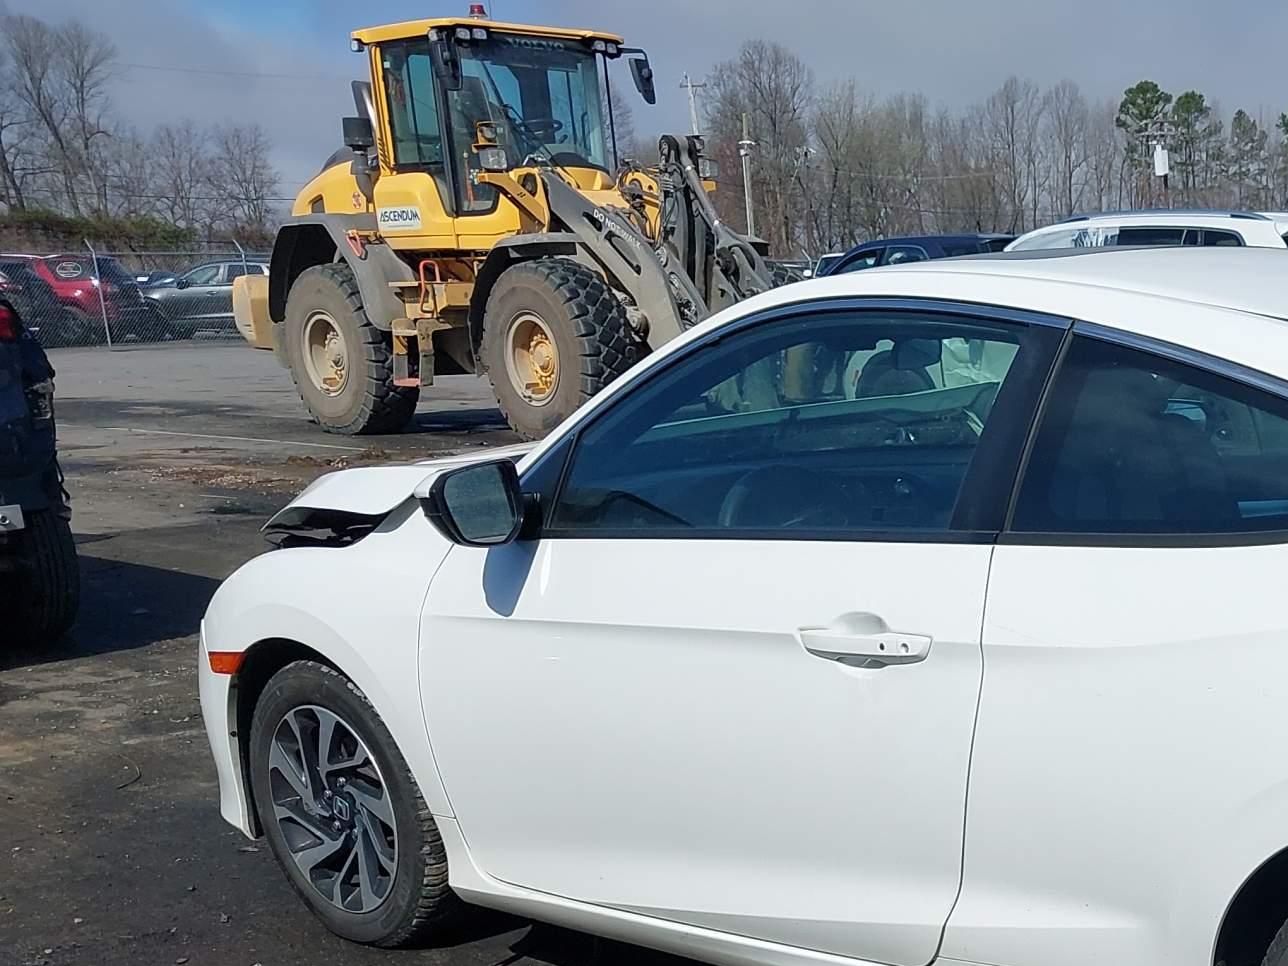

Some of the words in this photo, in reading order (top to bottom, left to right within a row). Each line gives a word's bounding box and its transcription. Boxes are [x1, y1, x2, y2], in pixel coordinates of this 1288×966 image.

[380, 210, 420, 222] ASCENDUM
[593, 209, 604, 221] DO
[605, 218, 620, 232] NOT
